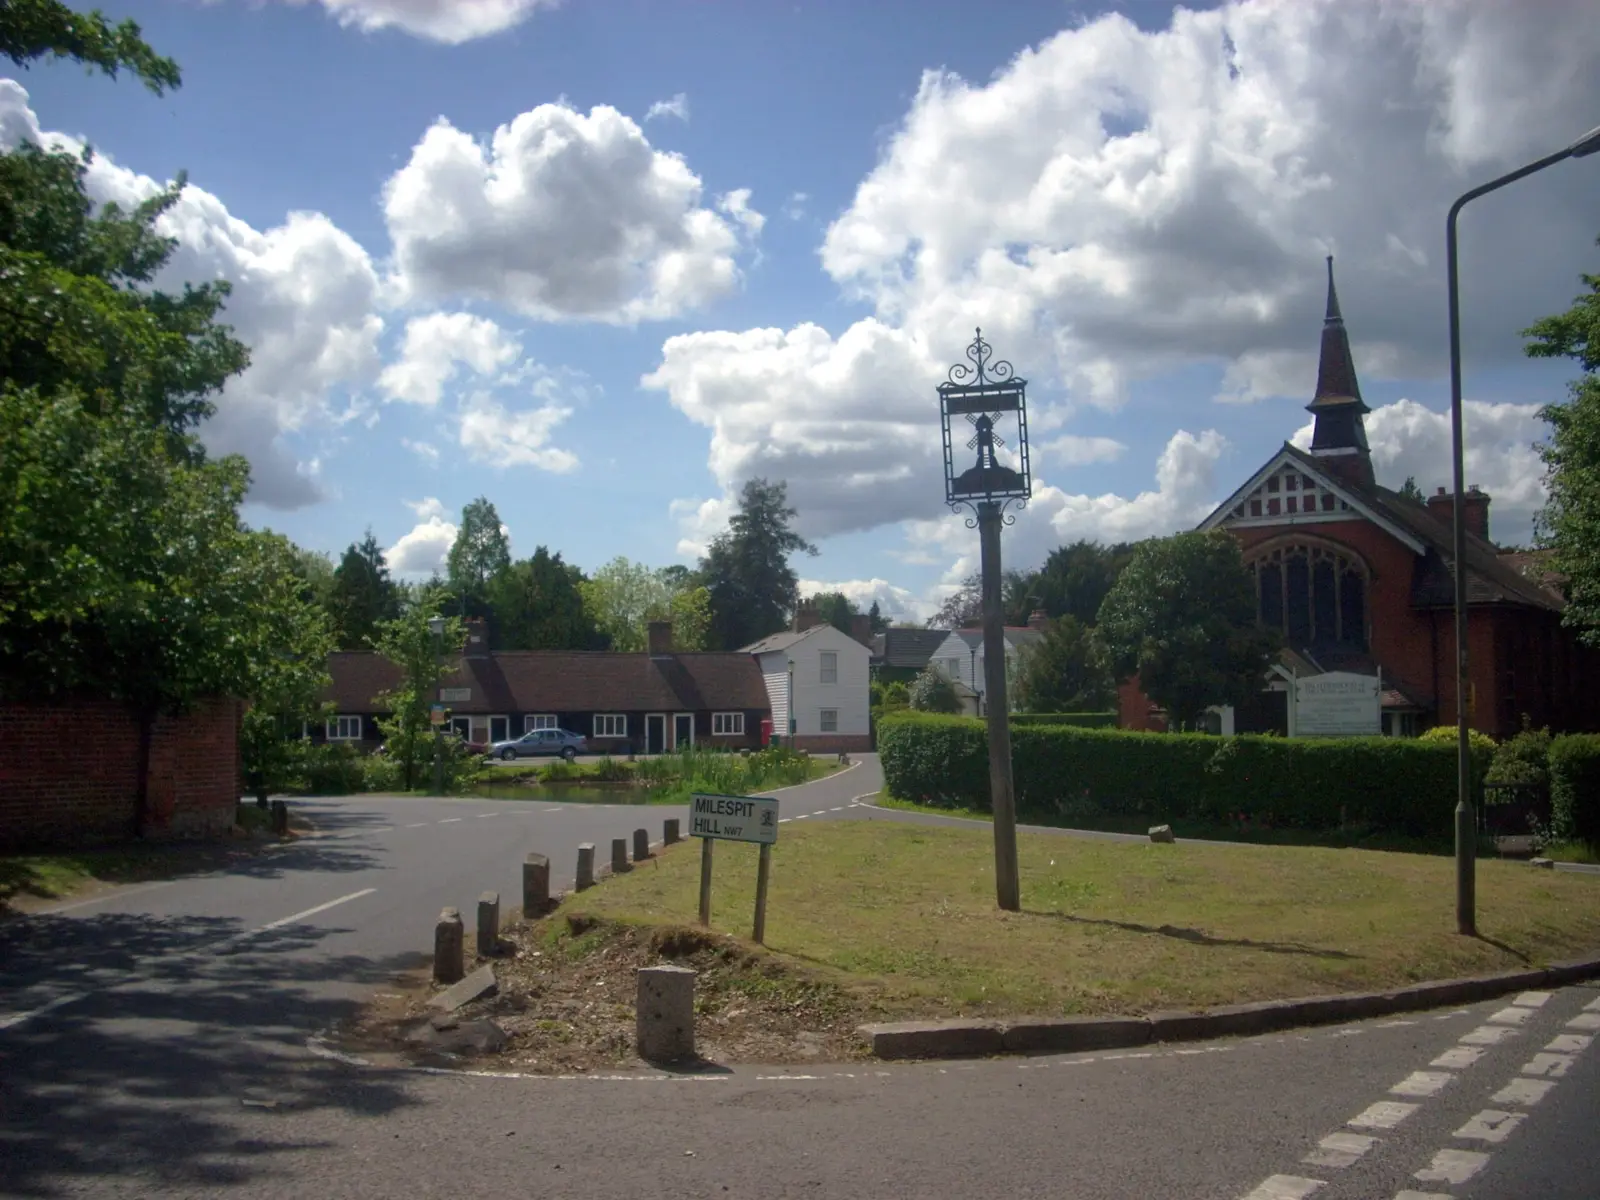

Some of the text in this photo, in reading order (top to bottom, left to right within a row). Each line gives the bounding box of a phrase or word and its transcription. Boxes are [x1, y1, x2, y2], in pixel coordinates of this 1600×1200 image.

[695, 798, 755, 817] MILESPIT
[694, 817, 743, 837] HILL NW7
